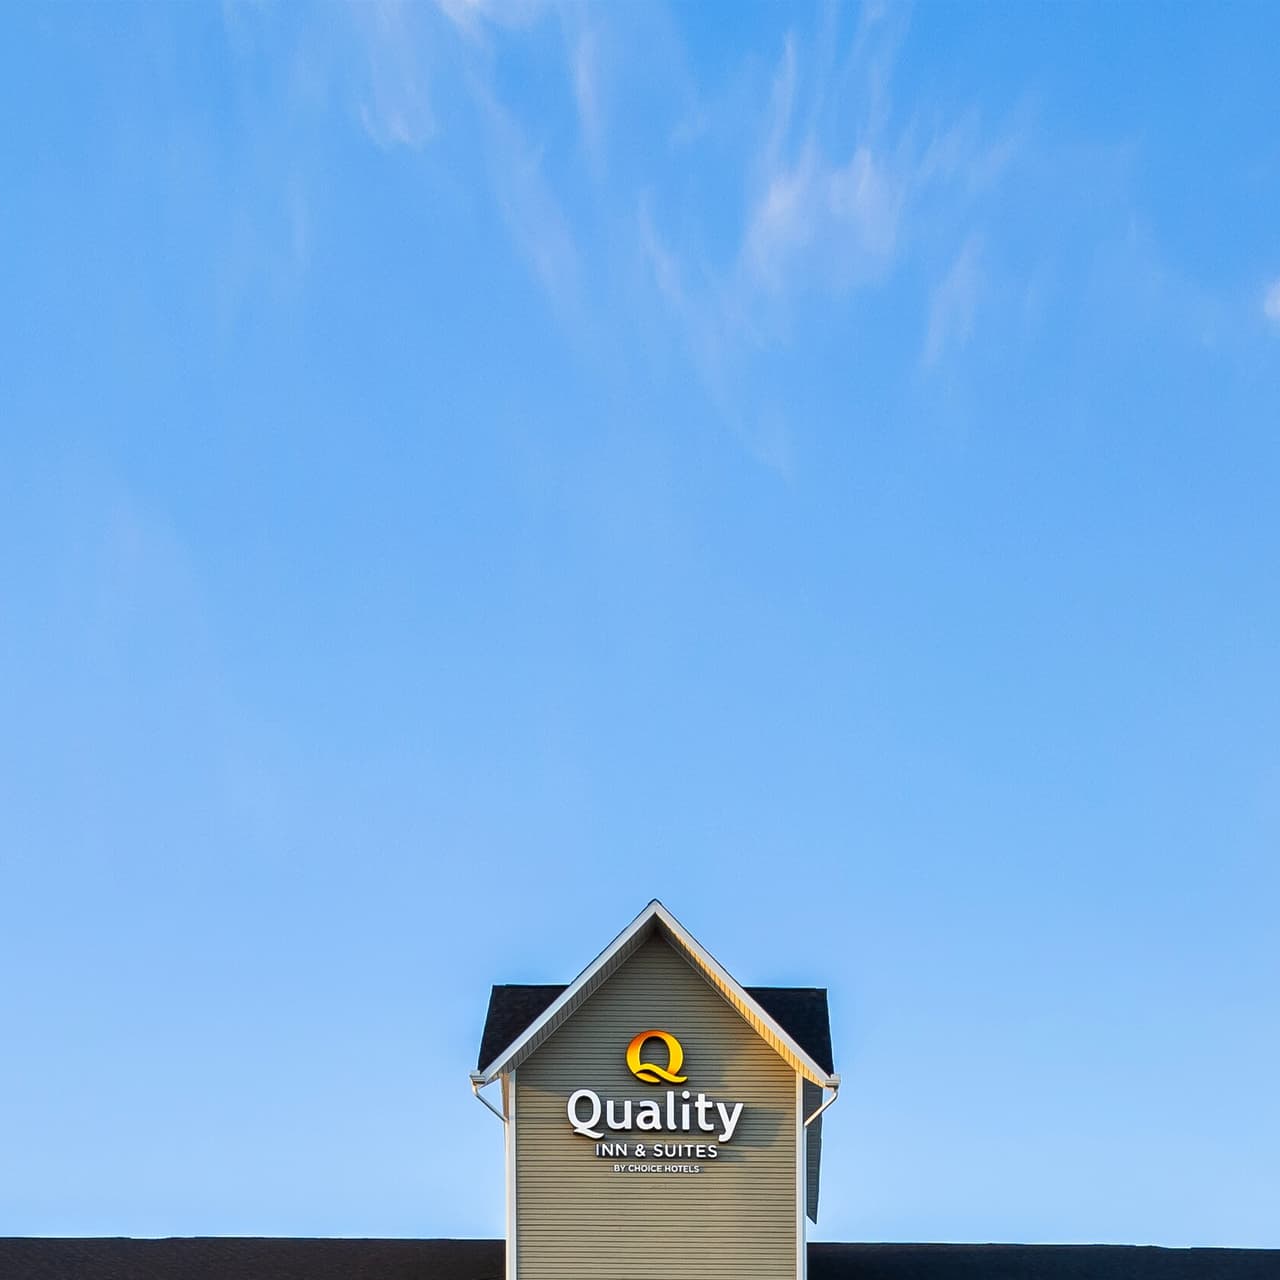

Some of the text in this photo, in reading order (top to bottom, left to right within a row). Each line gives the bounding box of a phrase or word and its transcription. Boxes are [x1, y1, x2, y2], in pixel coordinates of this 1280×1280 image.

[626, 1029, 688, 1083] Q
[567, 1089, 744, 1142] Quality
[596, 1143, 718, 1158] INN & SUITES
[613, 1164, 700, 1173] BY CHOICE HOTELS
